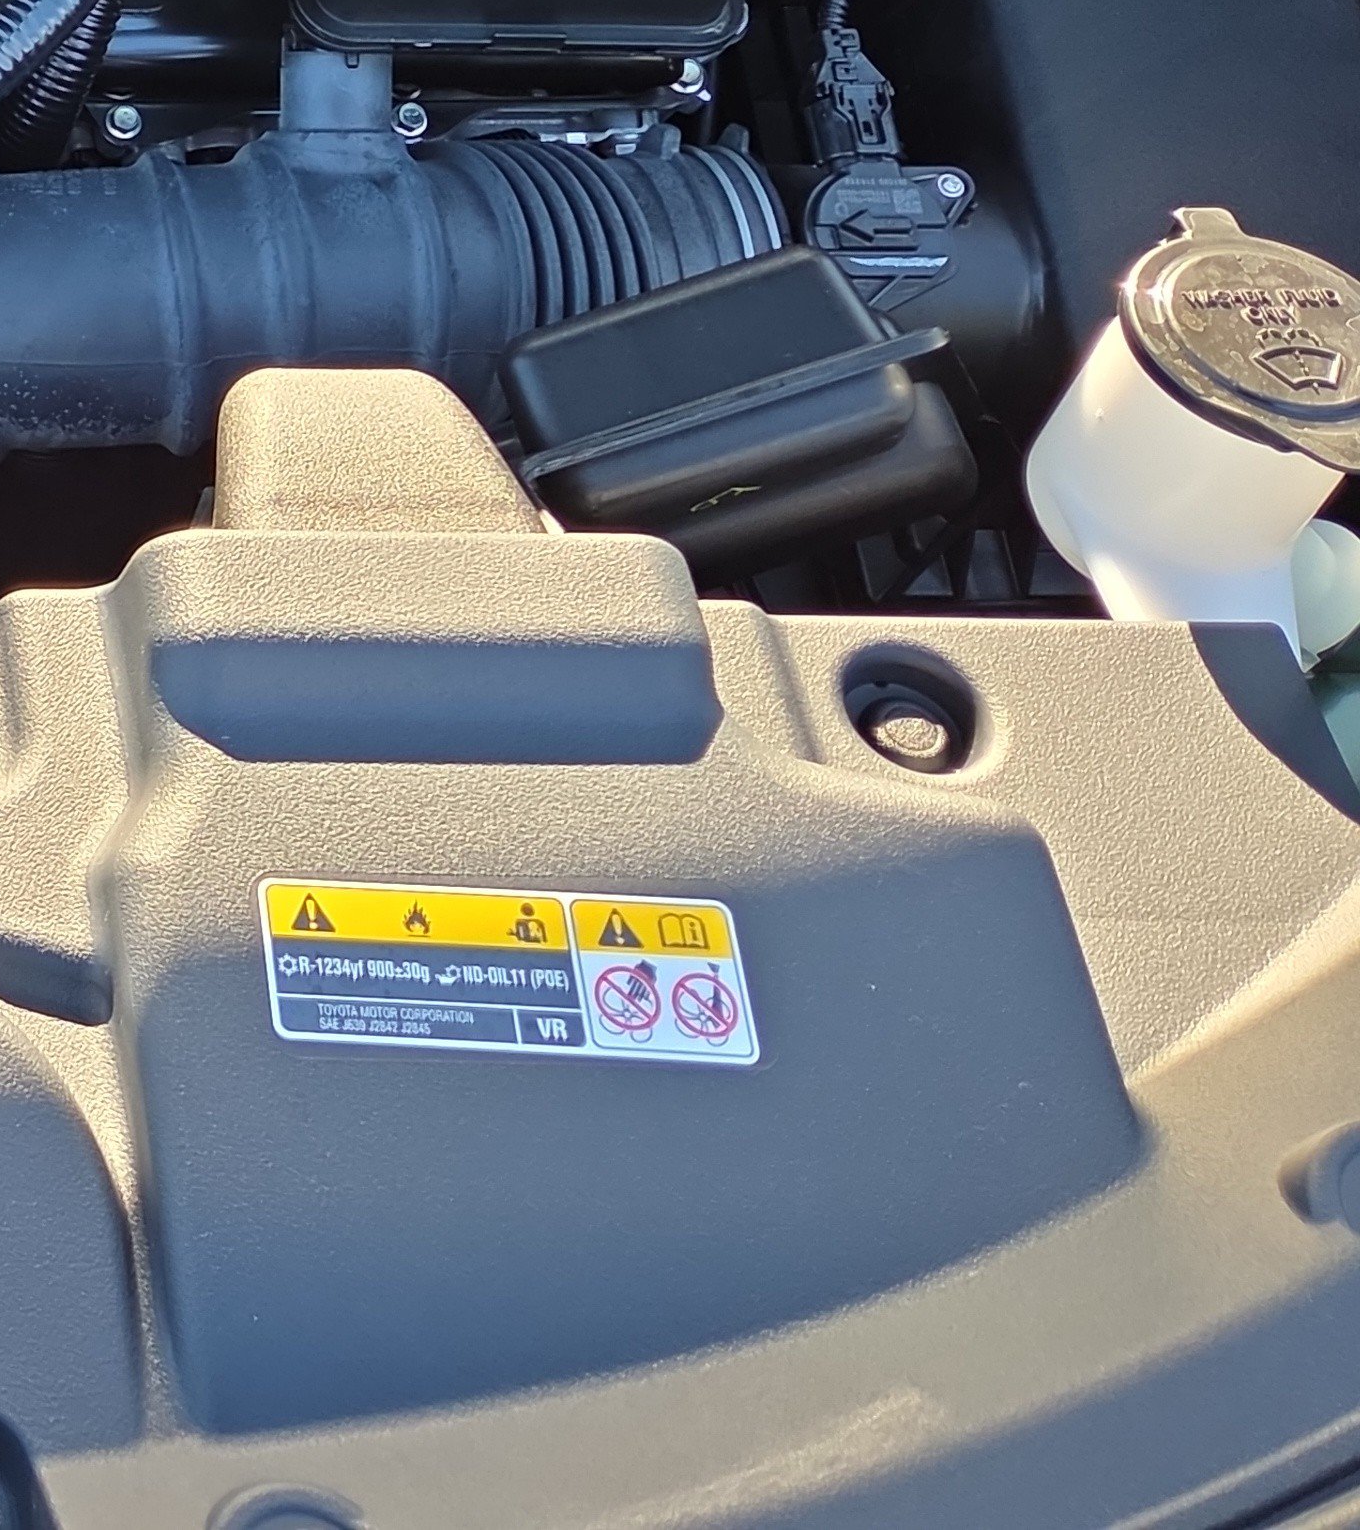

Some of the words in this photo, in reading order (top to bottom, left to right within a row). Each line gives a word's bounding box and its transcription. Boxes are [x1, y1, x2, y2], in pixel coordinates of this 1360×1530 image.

[1181, 288, 1274, 310] WASHER
[1275, 287, 1343, 308] FLUID
[1240, 306, 1300, 327] ONLY
[298, 955, 364, 982] R-1234yf
[366, 959, 430, 985] 900±30g
[530, 968, 570, 992] (POE)
[317, 1003, 357, 1016] TOYOTA
[359, 1005, 398, 1019] MOTOR
[399, 1007, 475, 1025] CORPORATION
[319, 1017, 340, 1030] SAE
[536, 1017, 568, 1042] VR
